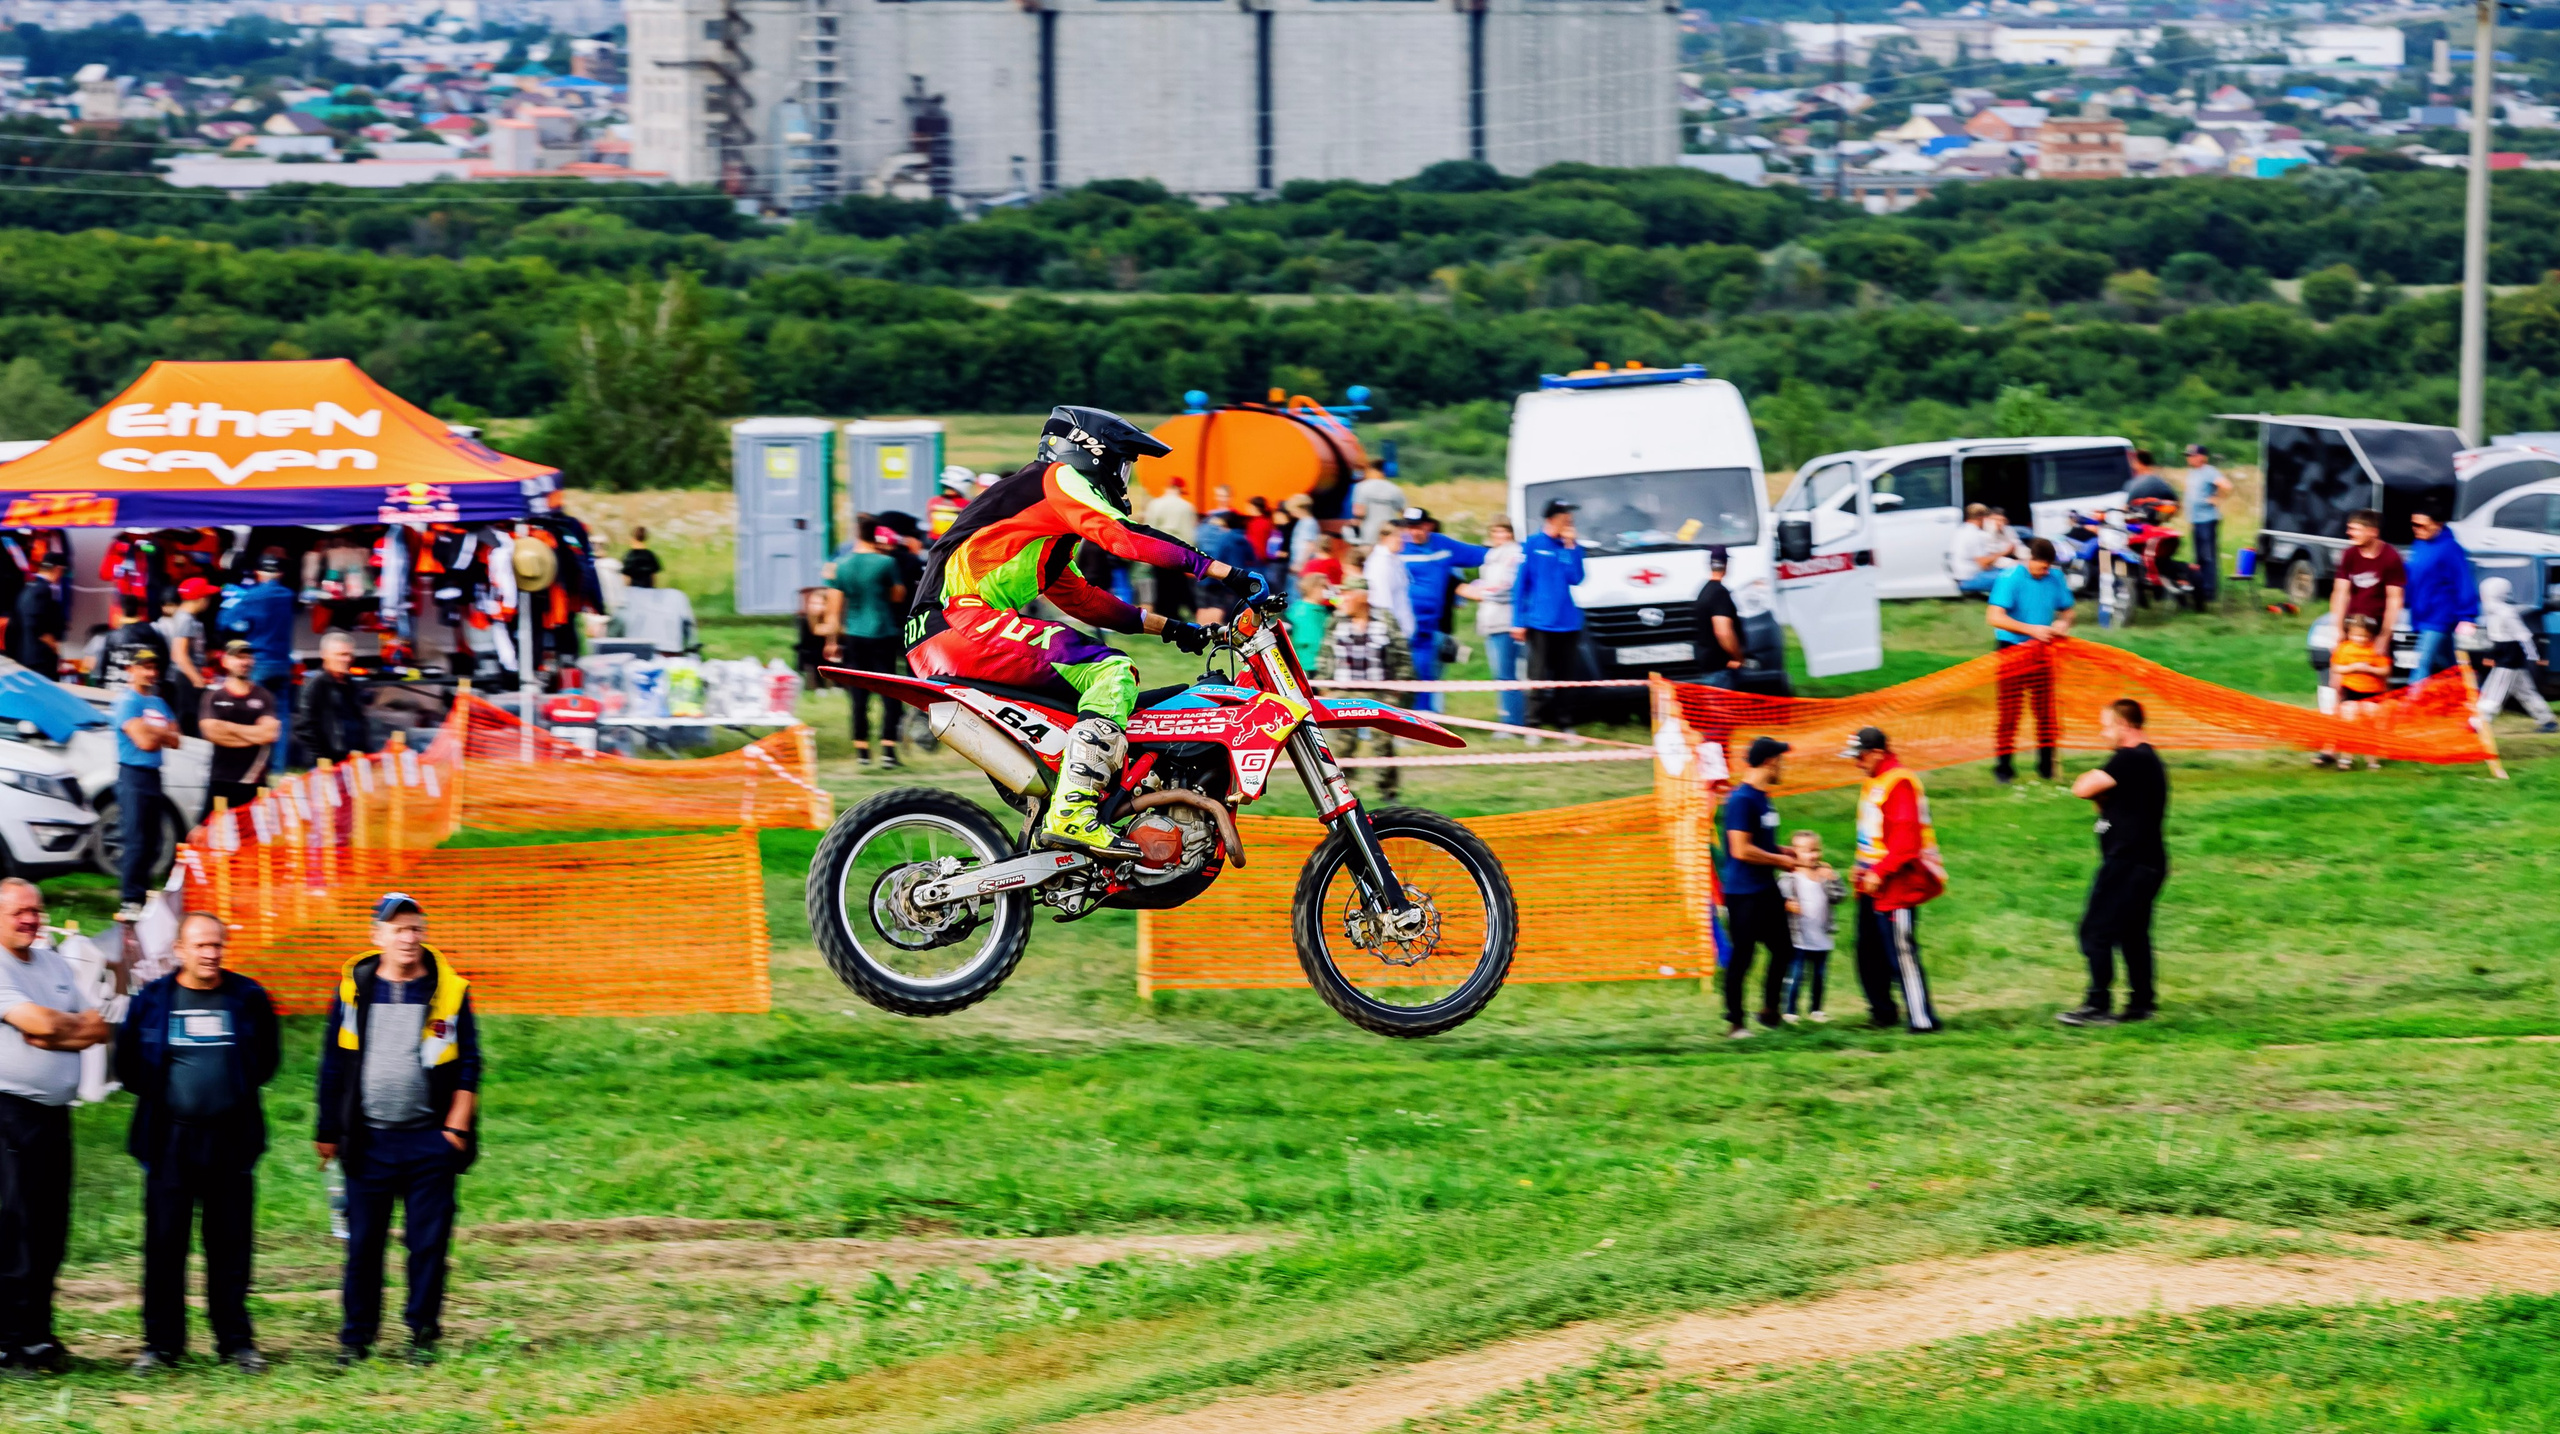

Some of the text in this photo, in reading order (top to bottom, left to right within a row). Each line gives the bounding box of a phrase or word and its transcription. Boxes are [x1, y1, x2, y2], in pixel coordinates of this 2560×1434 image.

[1183, 711, 1217, 719] RACING
[1337, 709, 1380, 718] GASGAS
[995, 706, 1050, 745] 64
[1125, 717, 1226, 736] GASGAS
[1055, 853, 1075, 866] RK
